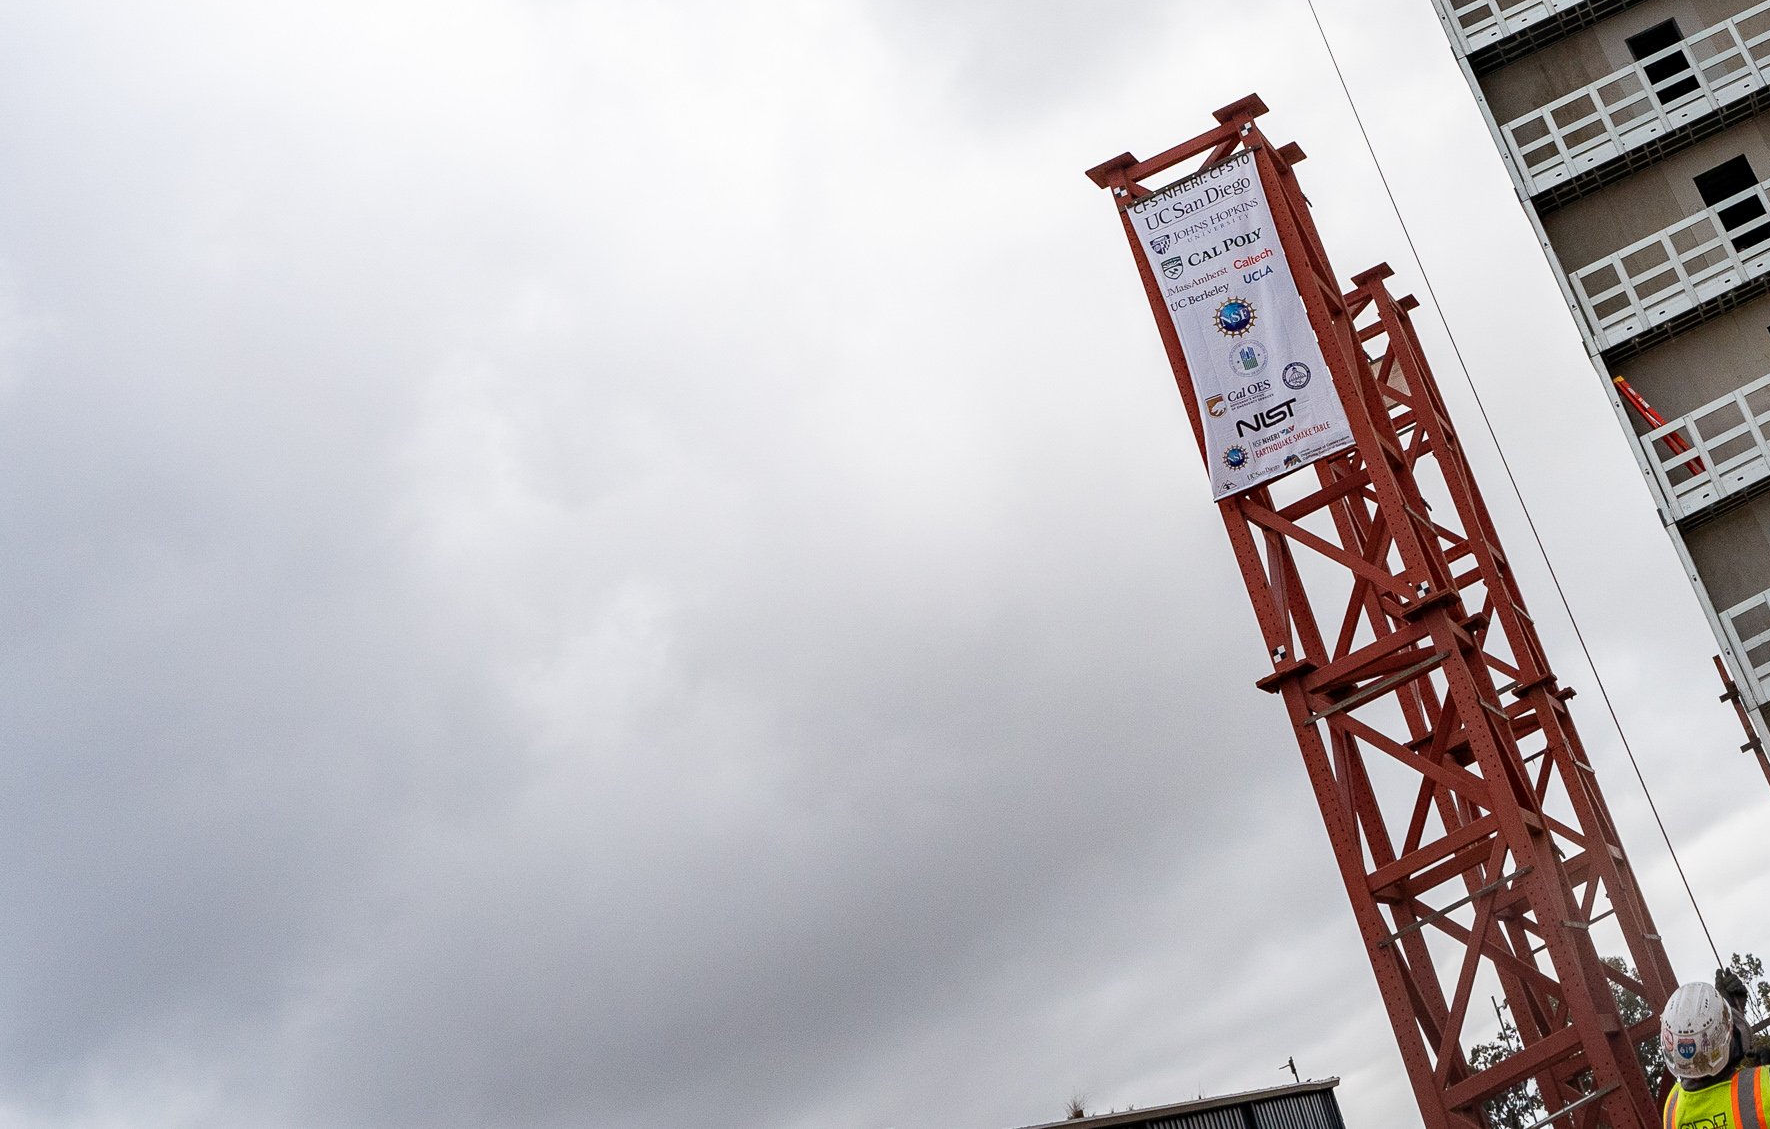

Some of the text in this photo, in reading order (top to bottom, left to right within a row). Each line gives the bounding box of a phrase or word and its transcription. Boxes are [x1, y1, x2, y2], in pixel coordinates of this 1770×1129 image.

[1133, 153, 1251, 215] CFS-NHERI: CFS10
[1145, 177, 1251, 231] UC San Diego
[1173, 197, 1259, 245] JOHNS HOPKINS
[1187, 213, 1250, 244] UNIVERSITY
[1187, 227, 1262, 267] CAL POLY
[1233, 247, 1274, 270] Caltech
[1242, 264, 1274, 285] UCLA
[1170, 283, 1230, 312] UC Berkeley
[1220, 307, 1249, 328] NSF
[1227, 379, 1271, 402] Cal OES
[1235, 397, 1297, 439] NIST
[1255, 420, 1331, 458] EARTHQUAKE SHAKE TABLE
[1262, 432, 1281, 445] NHERI
[1679, 1045, 1695, 1055] 619
